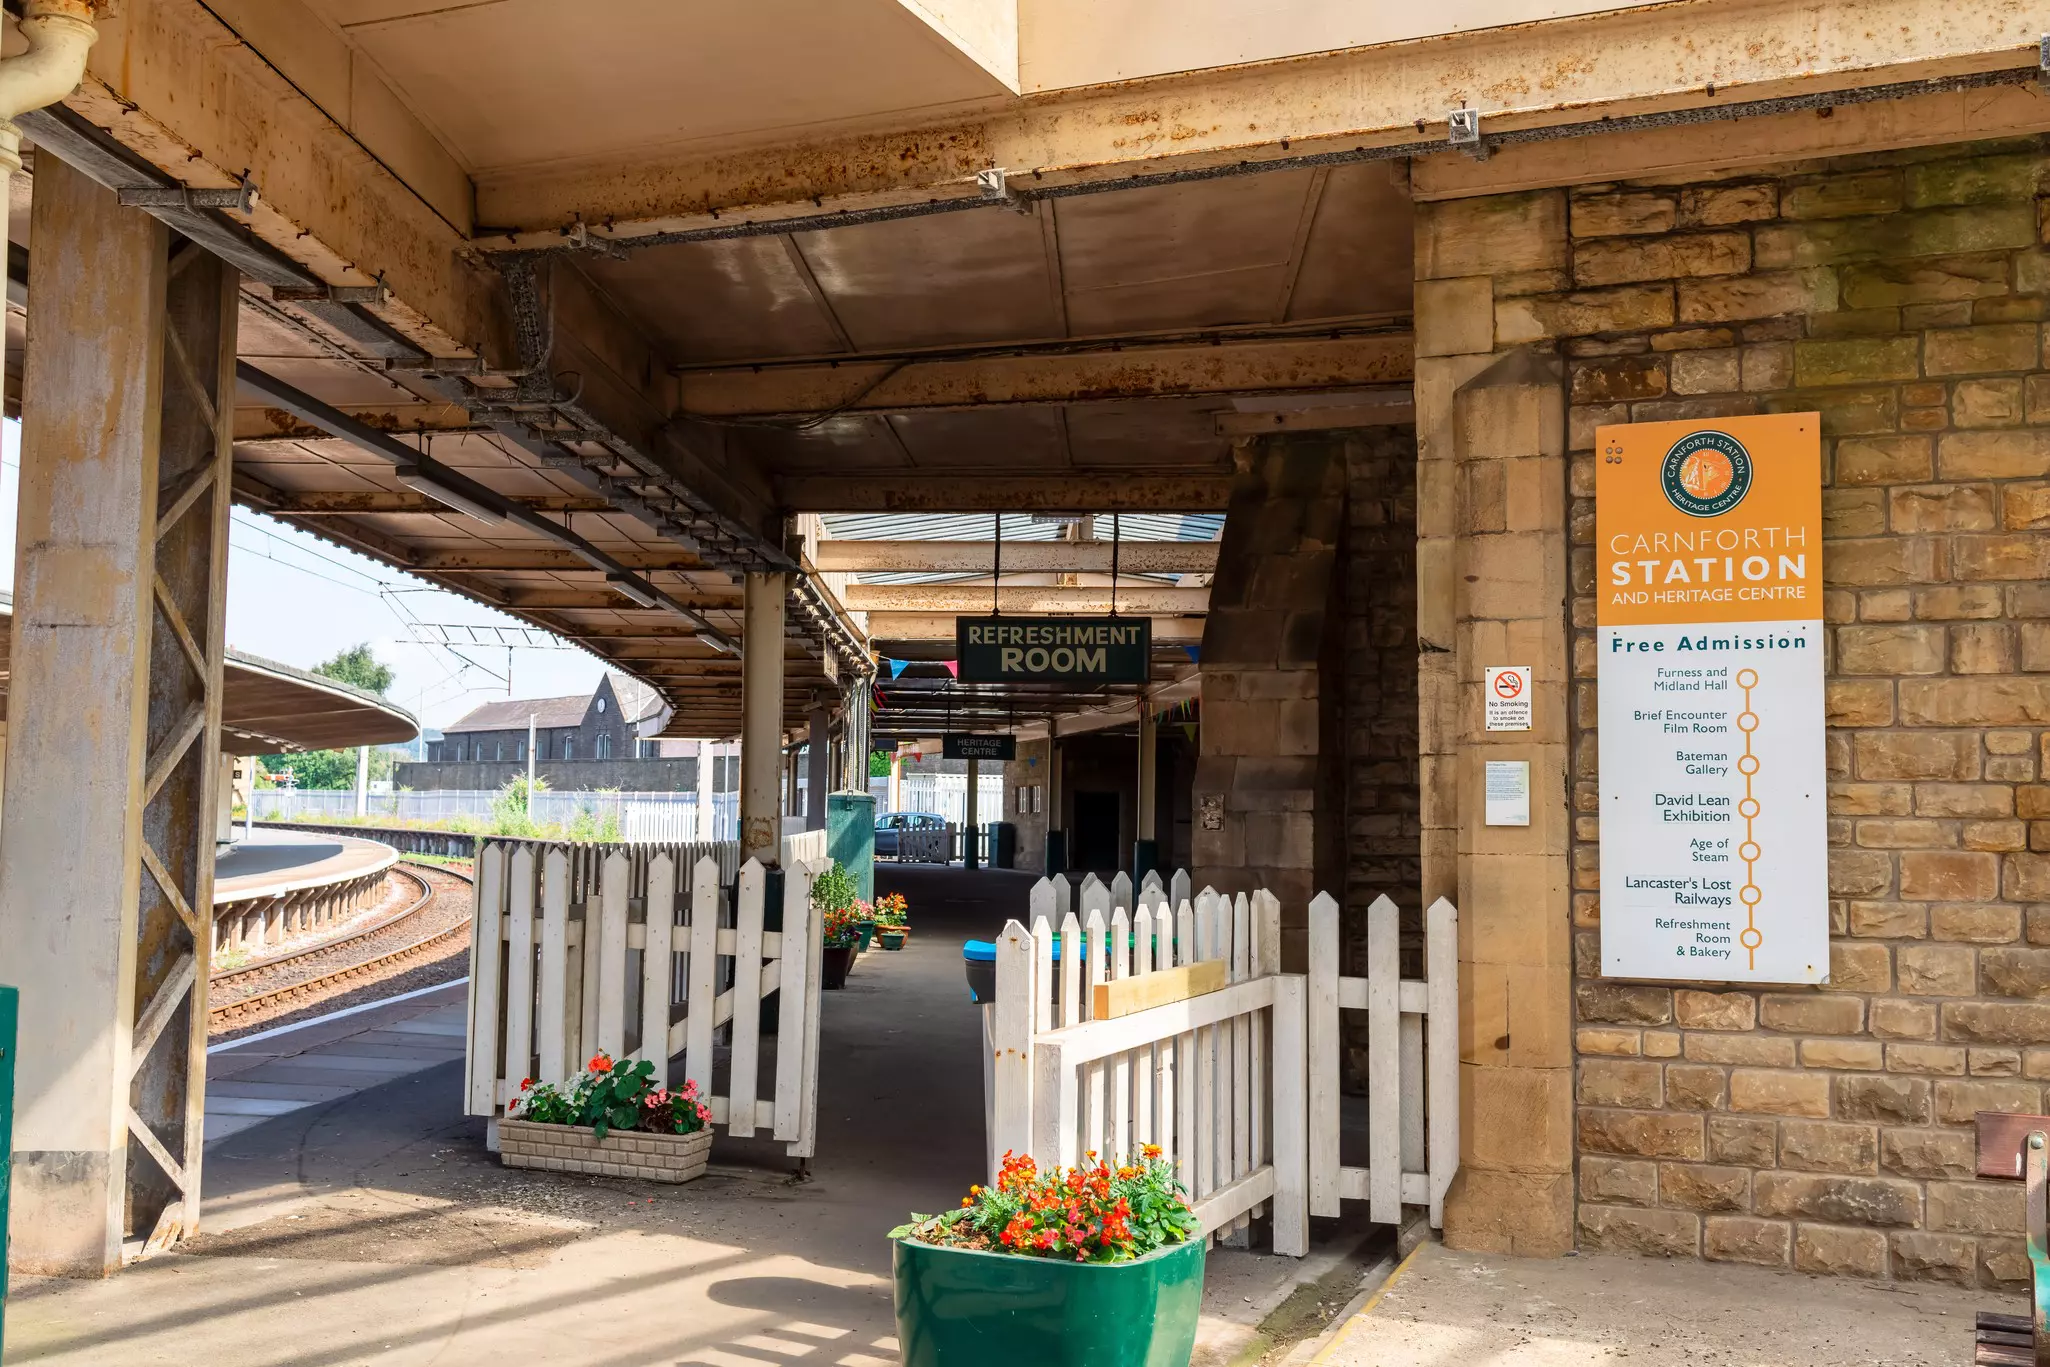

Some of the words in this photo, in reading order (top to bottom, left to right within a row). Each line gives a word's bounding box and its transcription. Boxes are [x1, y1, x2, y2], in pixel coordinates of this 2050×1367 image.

[1667, 437, 1715, 478] CARNFORTH
[1717, 439, 1746, 474] STATION
[1672, 488, 1710, 511] HERITAGE
[1712, 485, 1742, 510] CENTRE
[1610, 526, 1805, 555] CARNFORTH
[1611, 554, 1806, 586] STATION
[1612, 591, 1649, 605] AND
[1654, 588, 1733, 604] HERITAGE
[1738, 585, 1806, 601] CENTRE
[968, 626, 1141, 645] REFRESHMENT
[1612, 638, 1665, 653] Free
[1677, 634, 1807, 651] Admission
[1001, 647, 1107, 673] ROOM
[1657, 667, 1702, 678] Furness
[1706, 667, 1728, 677] and
[1654, 680, 1700, 691] Midland
[1704, 680, 1728, 690] Hall
[1634, 710, 1663, 721] Brief
[1666, 710, 1728, 720] Encounter
[1663, 723, 1688, 733] Film
[1693, 723, 1727, 733] Room
[957, 739, 1002, 747] HERITAGE
[961, 747, 997, 756] CENTRE
[1676, 751, 1728, 761] Bateman
[1685, 764, 1728, 777] Gallery
[1655, 793, 1693, 806] David
[1698, 794, 1730, 806] Lean
[1663, 809, 1731, 822] Exhibition
[1690, 838, 1713, 851] Age
[1716, 838, 1730, 849] of
[1692, 852, 1729, 862] Steam
[1625, 875, 1698, 889] Lancaster's
[1702, 877, 1732, 890] Lost
[1675, 892, 1732, 908] Railways
[1655, 918, 1730, 930] Refreshment
[1696, 933, 1731, 944] Room
[1676, 946, 1685, 956] &
[1690, 946, 1731, 960] Bakery
